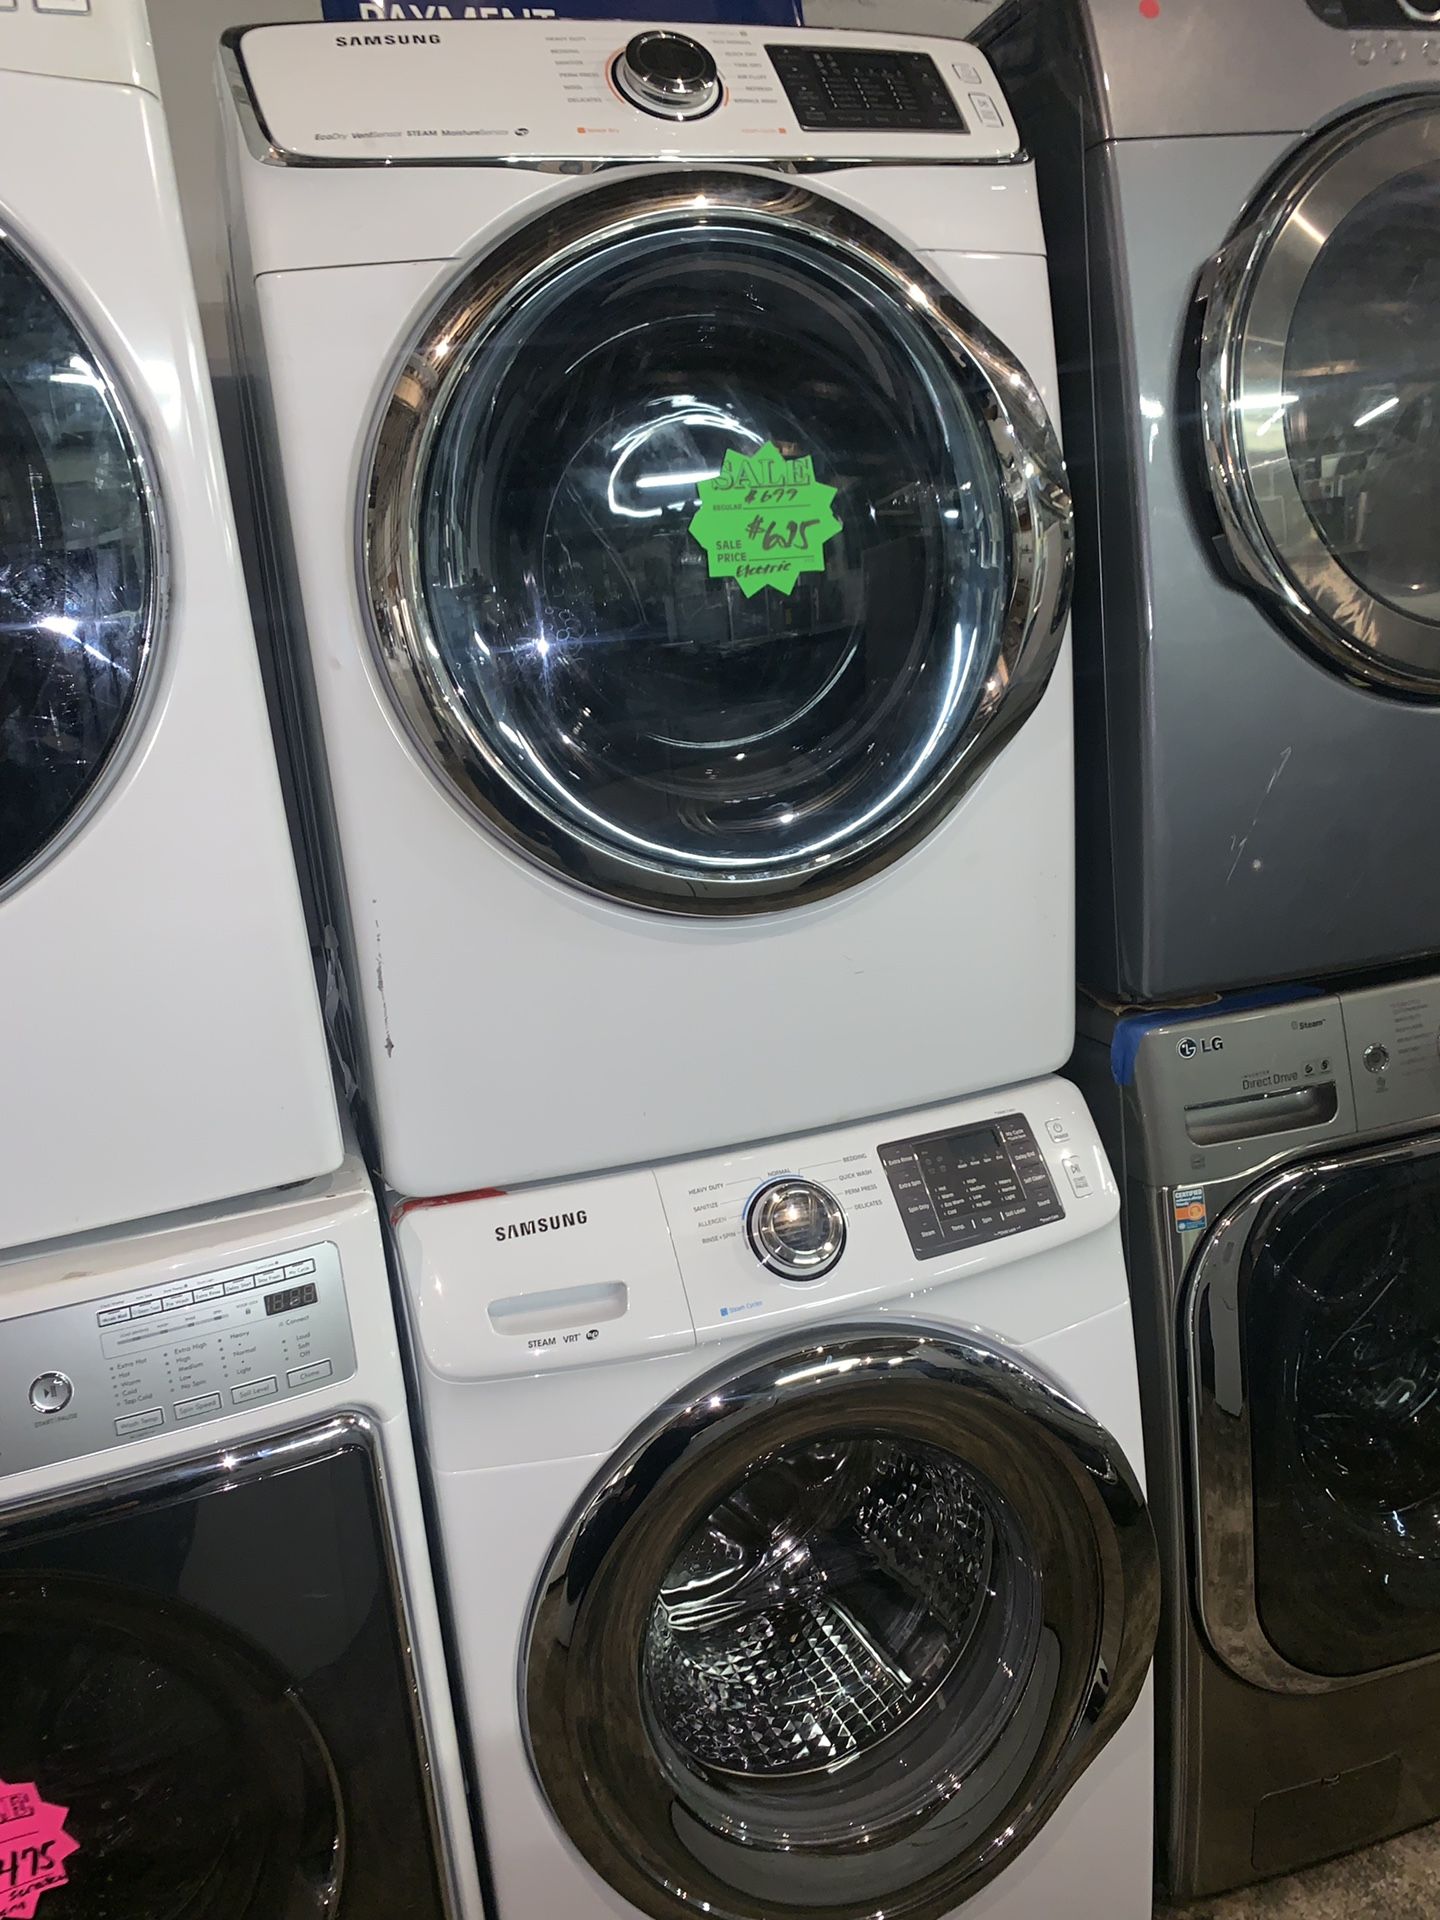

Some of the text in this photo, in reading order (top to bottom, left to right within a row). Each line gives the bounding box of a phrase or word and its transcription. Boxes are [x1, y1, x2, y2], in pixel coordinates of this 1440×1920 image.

[336, 34, 441, 47] SAMSUNG
[711, 458, 811, 491] SALE
[715, 539, 742, 551] SALE
[717, 552, 747, 563] PRICE
[1200, 1036, 1224, 1053] LG
[1242, 1071, 1298, 1091] Direct Drive
[839, 1169, 872, 1181] QUICK WASH
[688, 1186, 707, 1195] HEAVY
[845, 1187, 860, 1195] PERM
[693, 1202, 719, 1212] SANITIZE
[854, 1199, 883, 1210] DELICATES
[495, 1210, 588, 1241] SAMSUNG
[698, 1217, 727, 1227] ALLERGEN
[230, 1331, 249, 1339] Heavy
[296, 1332, 311, 1341] Loud
[174, 1342, 207, 1354] Extra High
[528, 1337, 556, 1349] STEAM
[233, 1346, 256, 1357] Normal
[117, 1362, 134, 1370] Extra
[178, 1362, 204, 1371] Medium
[122, 1388, 137, 1396] Cold
